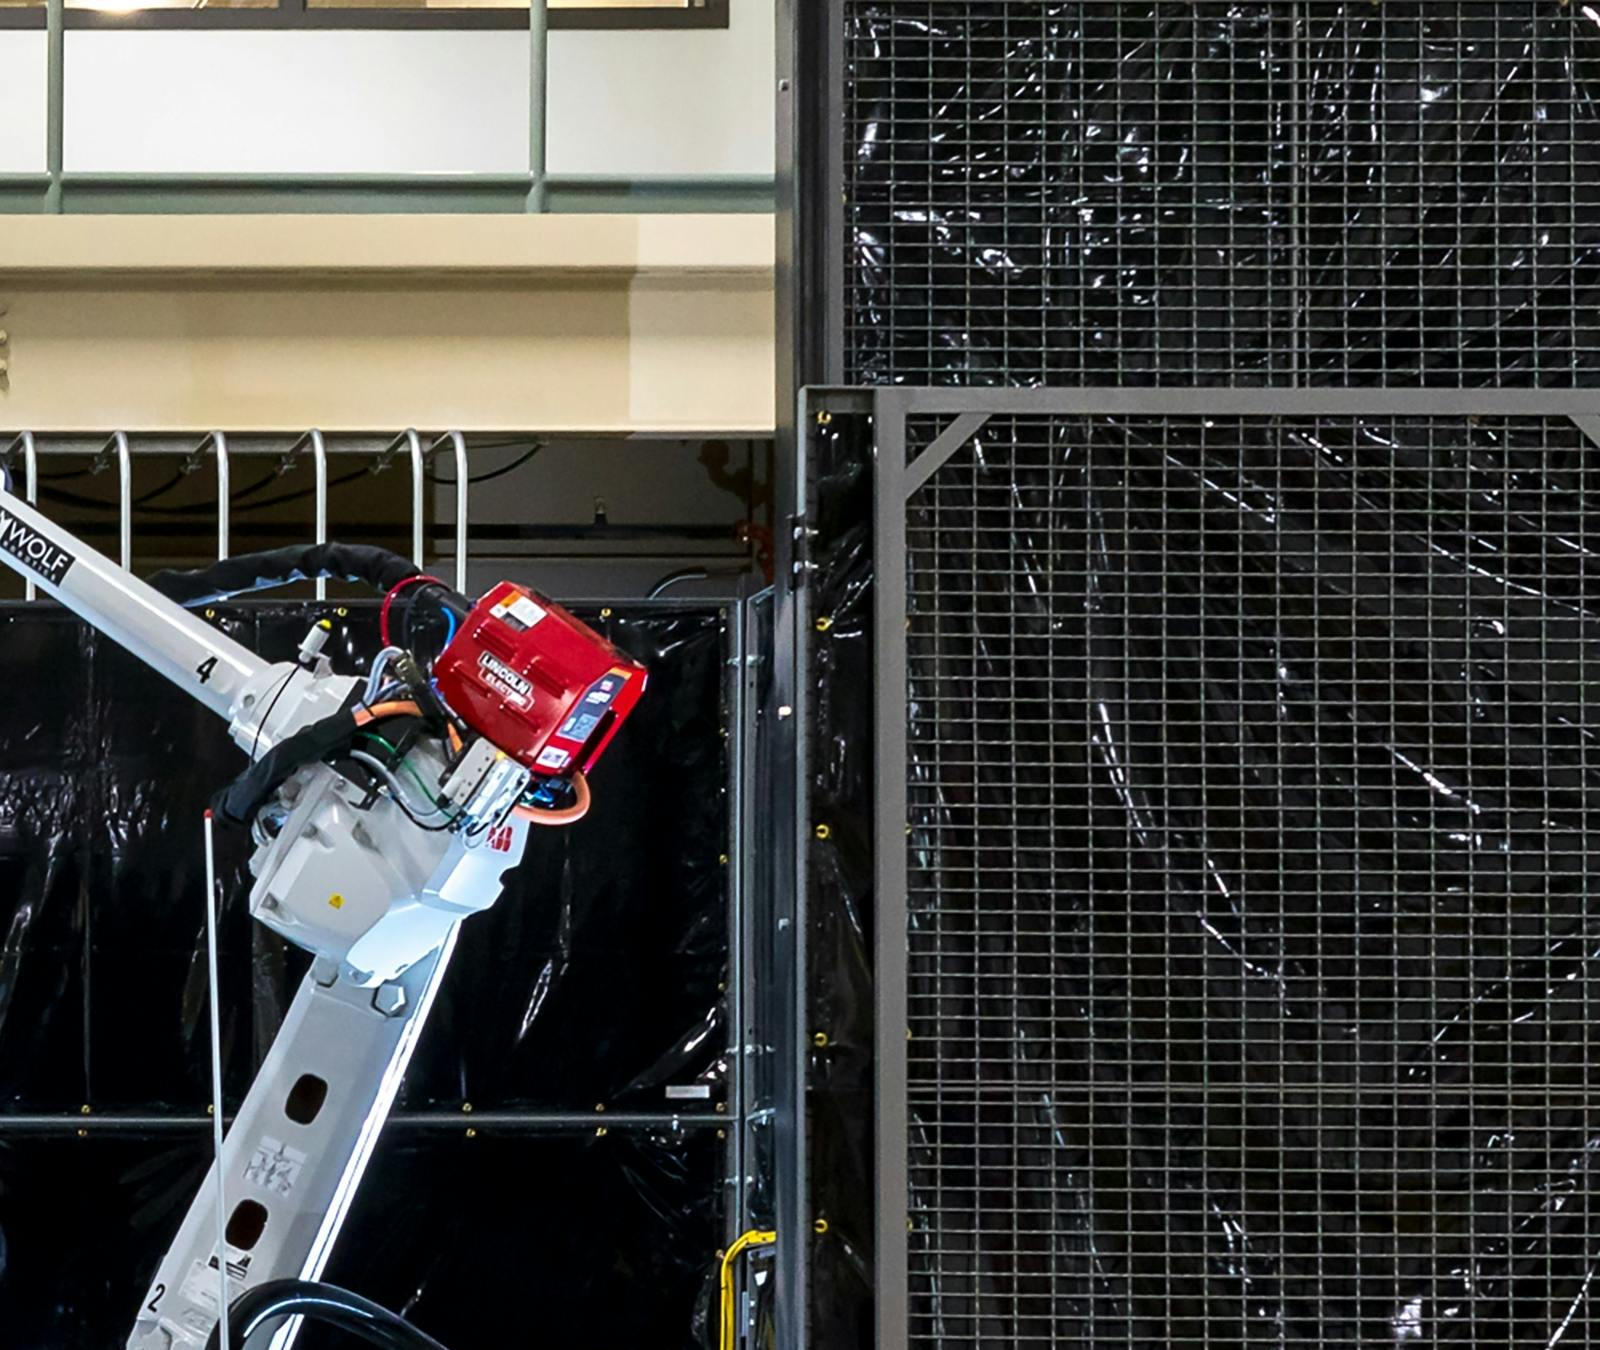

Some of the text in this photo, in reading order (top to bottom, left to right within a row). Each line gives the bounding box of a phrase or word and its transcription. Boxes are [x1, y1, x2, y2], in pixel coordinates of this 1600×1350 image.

[8, 521, 68, 571] WOLF
[196, 656, 218, 684] 4
[481, 655, 531, 695] LINCOLN
[147, 1283, 166, 1313] 2
